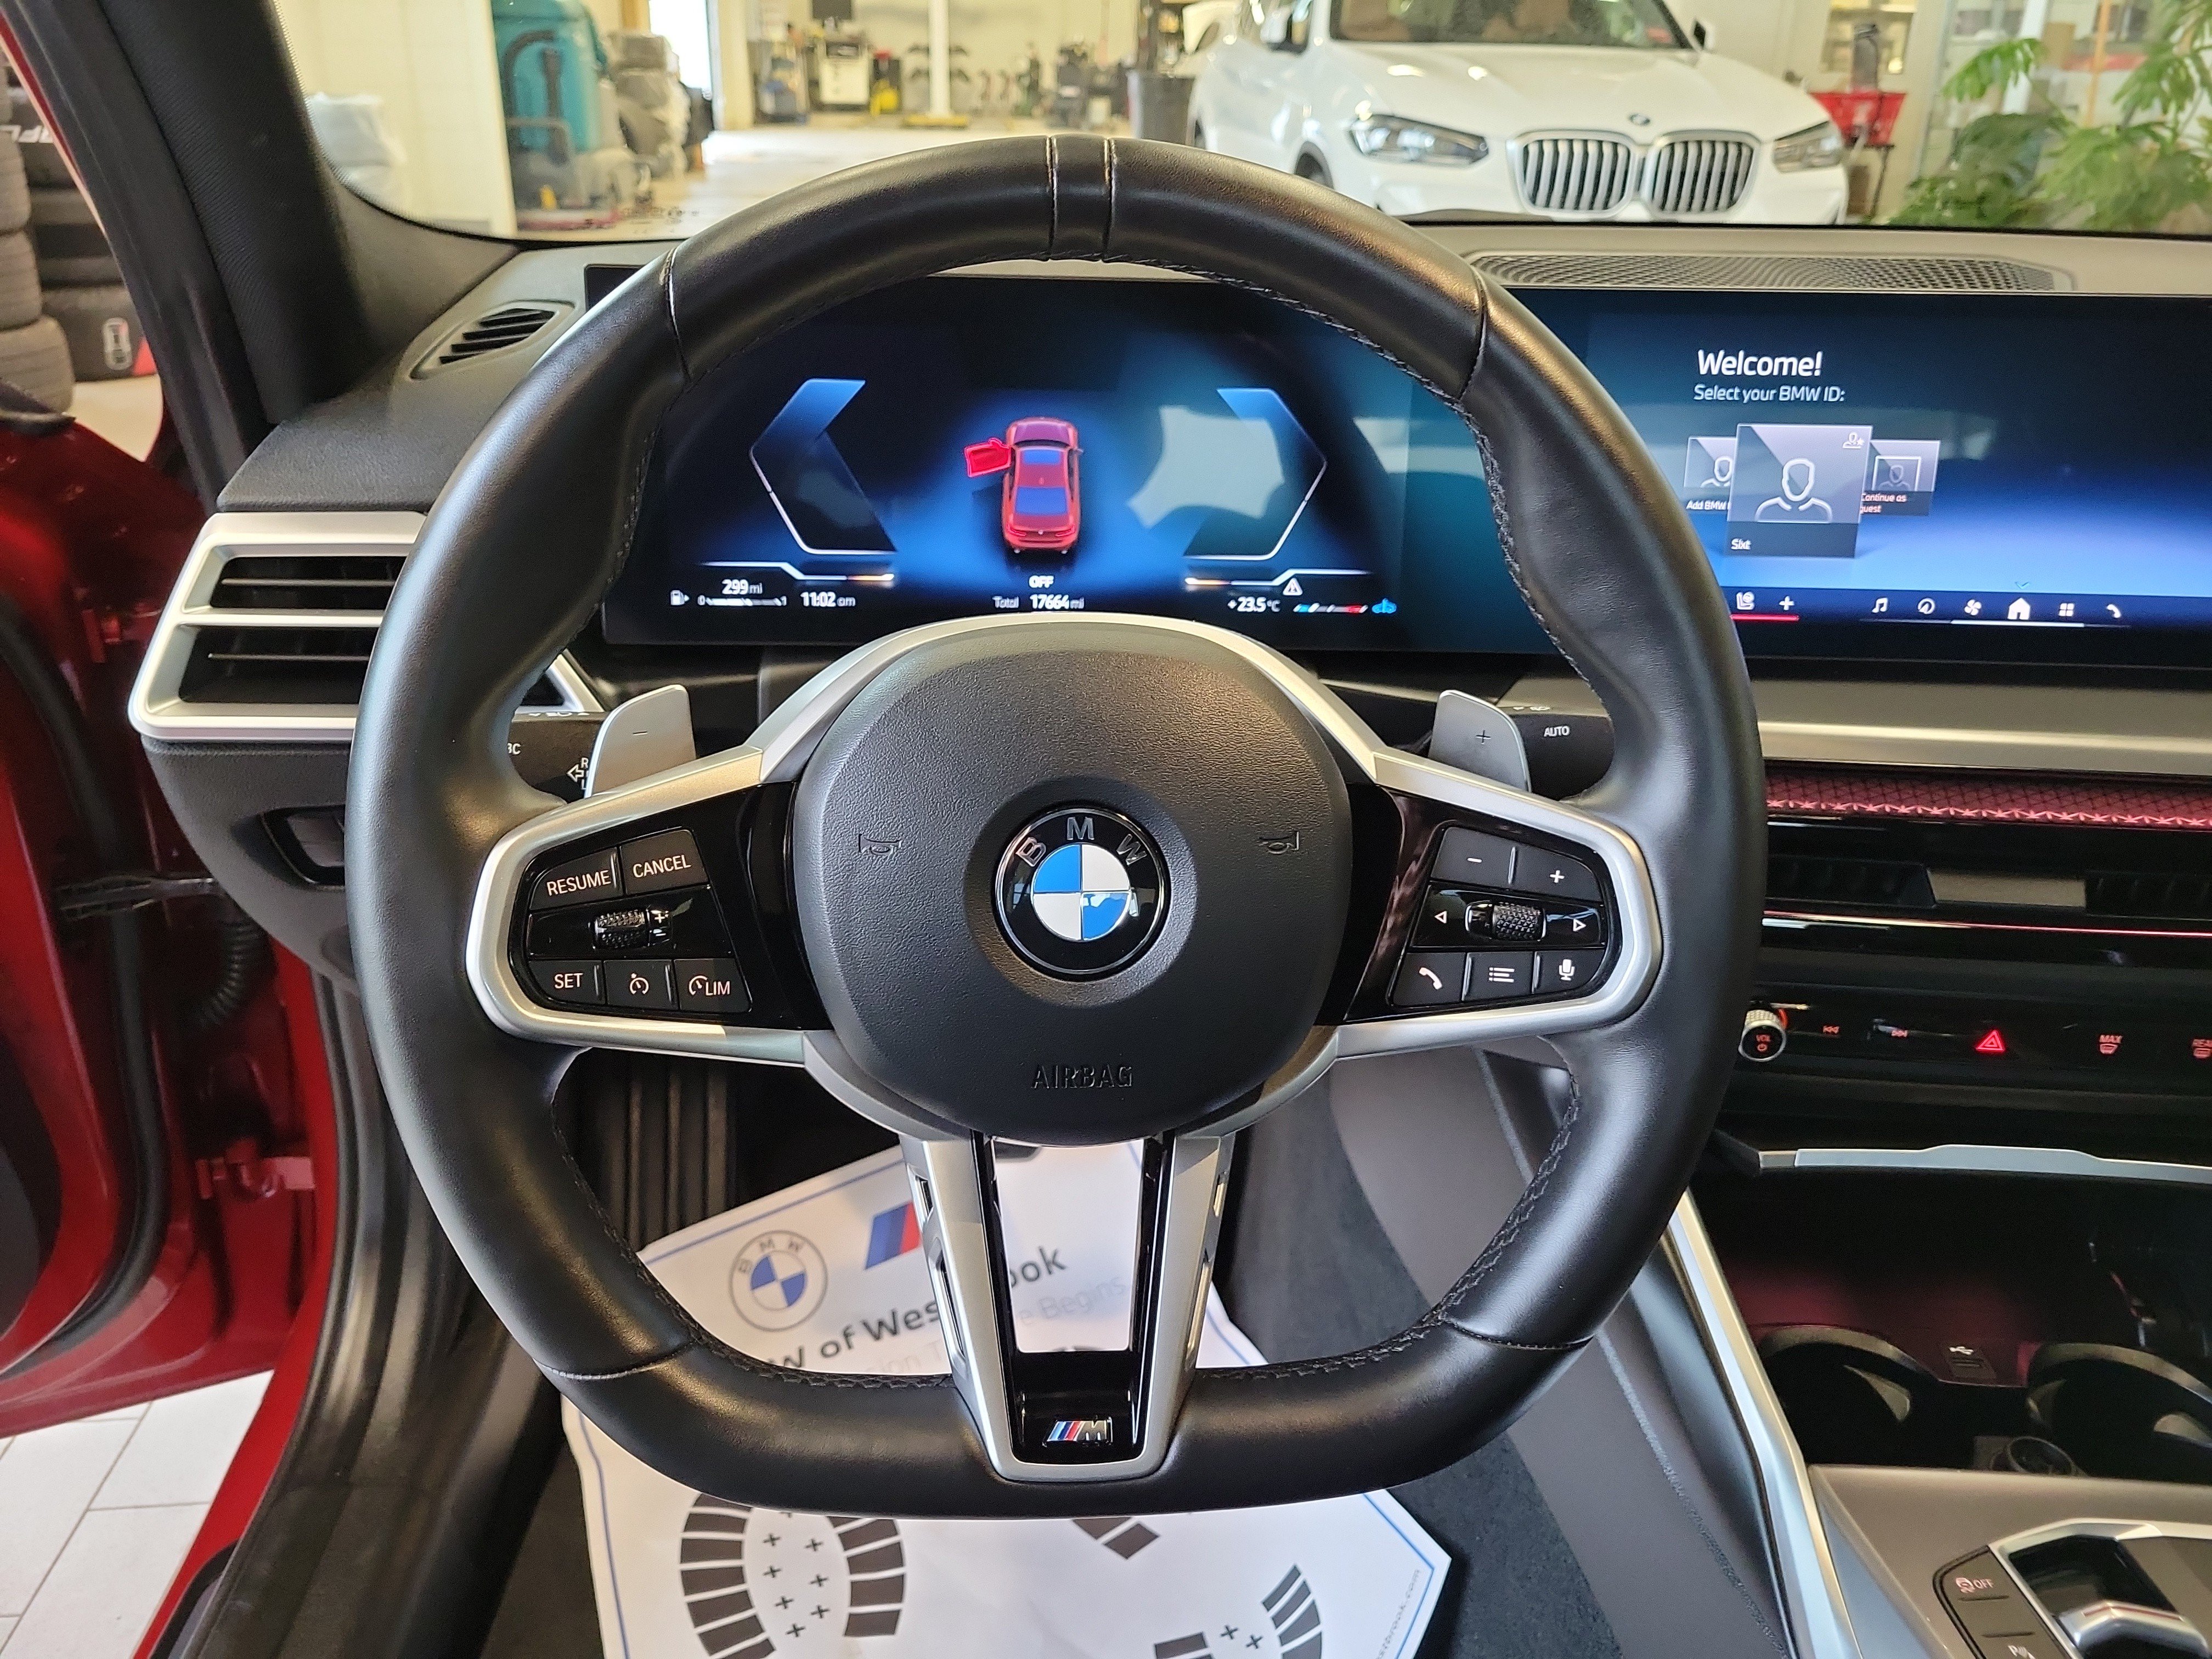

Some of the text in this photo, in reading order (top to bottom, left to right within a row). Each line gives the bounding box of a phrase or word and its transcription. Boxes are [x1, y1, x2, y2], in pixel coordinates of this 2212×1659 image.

[1697, 349, 1823, 376] Welcome!
[1693, 383, 1846, 404] Select your BMW ID:
[1686, 500, 1704, 510] Add
[1704, 500, 1727, 510] BMW
[1861, 493, 1908, 503] Continue as
[1860, 505, 1882, 514] guest
[1731, 538, 1751, 550] Sixt
[721, 579, 763, 594] 299 mi
[1029, 575, 1054, 589] OFF
[800, 591, 856, 607] 11:02 am
[992, 594, 1085, 610] Total 17664 mi
[1543, 725, 1570, 737] AUTO
[1015, 816, 1148, 867] BMW
[633, 854, 692, 878] CANCEL
[546, 870, 612, 896] RESUME
[554, 973, 584, 989] SET
[706, 980, 730, 996] LIM
[2099, 1034, 2123, 1043] MAX
[2193, 1039, 2212, 1047] REA
[1031, 1064, 1132, 1089] AIRBAG
[821, 1323, 857, 1358] of
[1973, 1578, 1994, 1589] OFF
